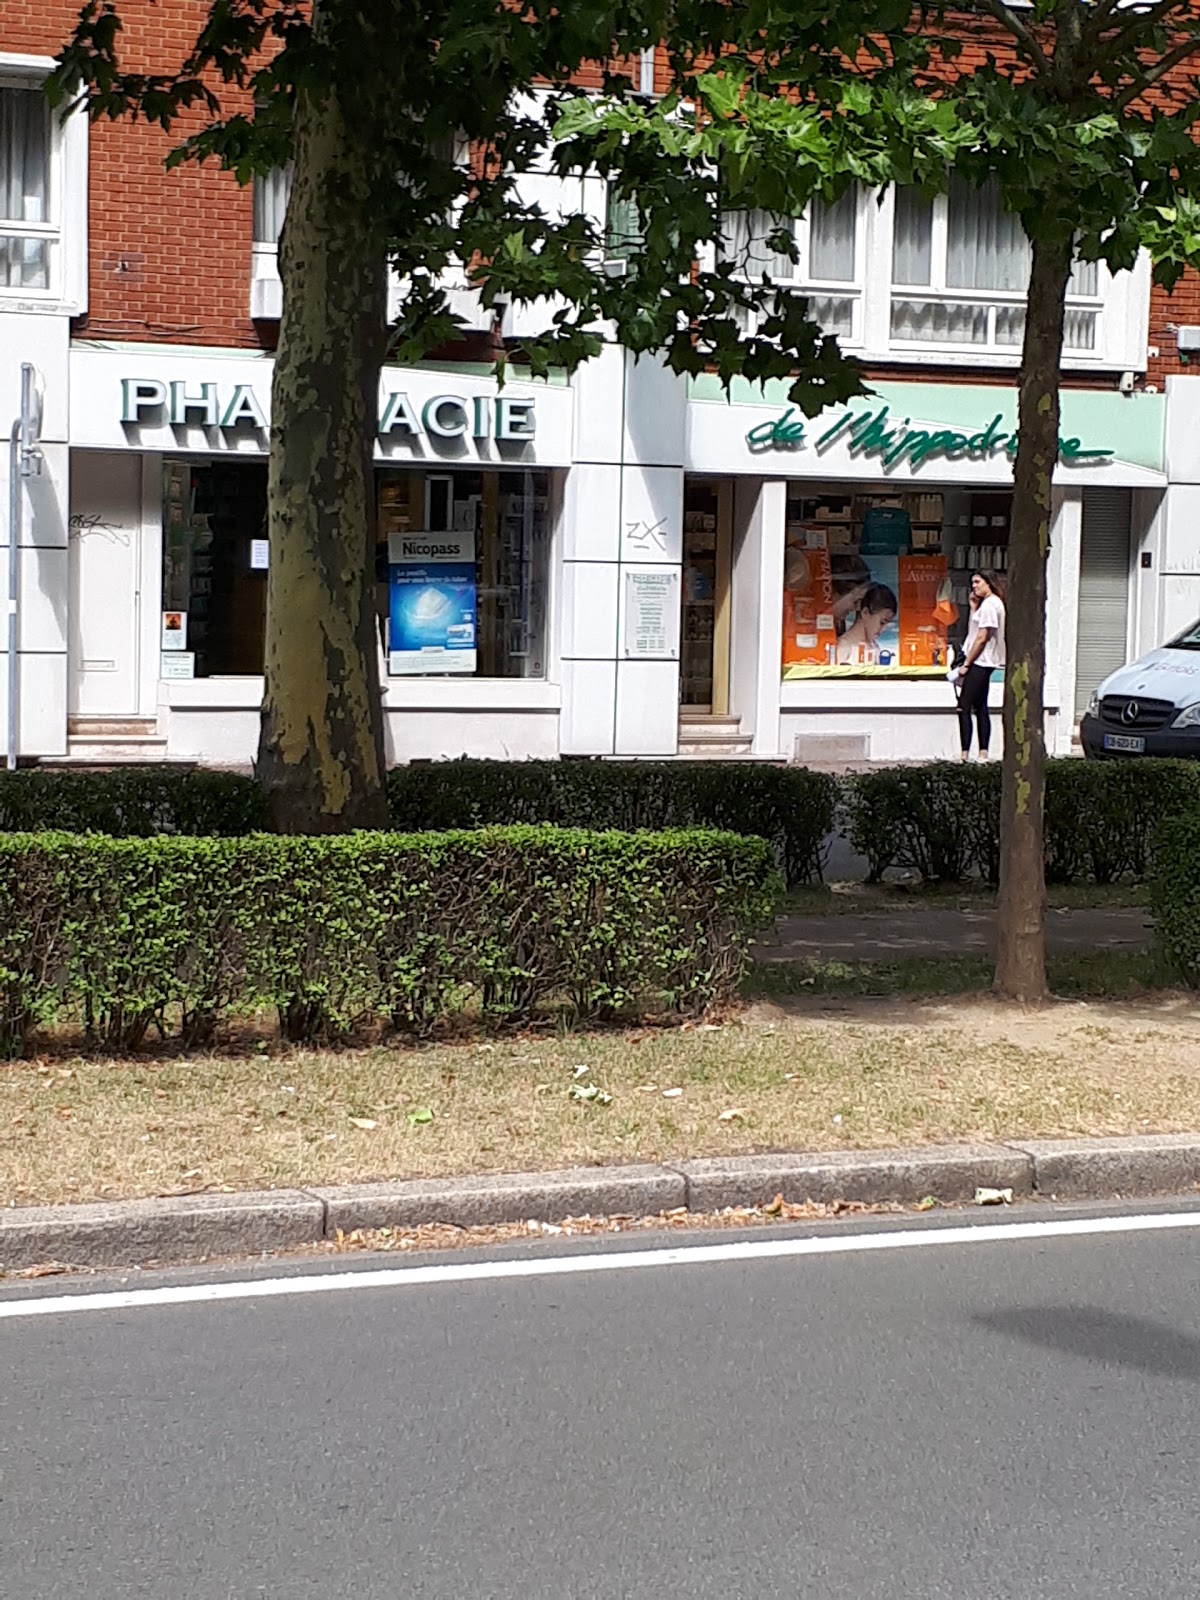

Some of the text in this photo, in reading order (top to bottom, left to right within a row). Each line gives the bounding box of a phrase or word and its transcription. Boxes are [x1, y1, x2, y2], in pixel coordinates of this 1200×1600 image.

[121, 378, 535, 441] PHAACIE
[747, 408, 807, 443] de
[403, 542, 460, 558] Nicopass
